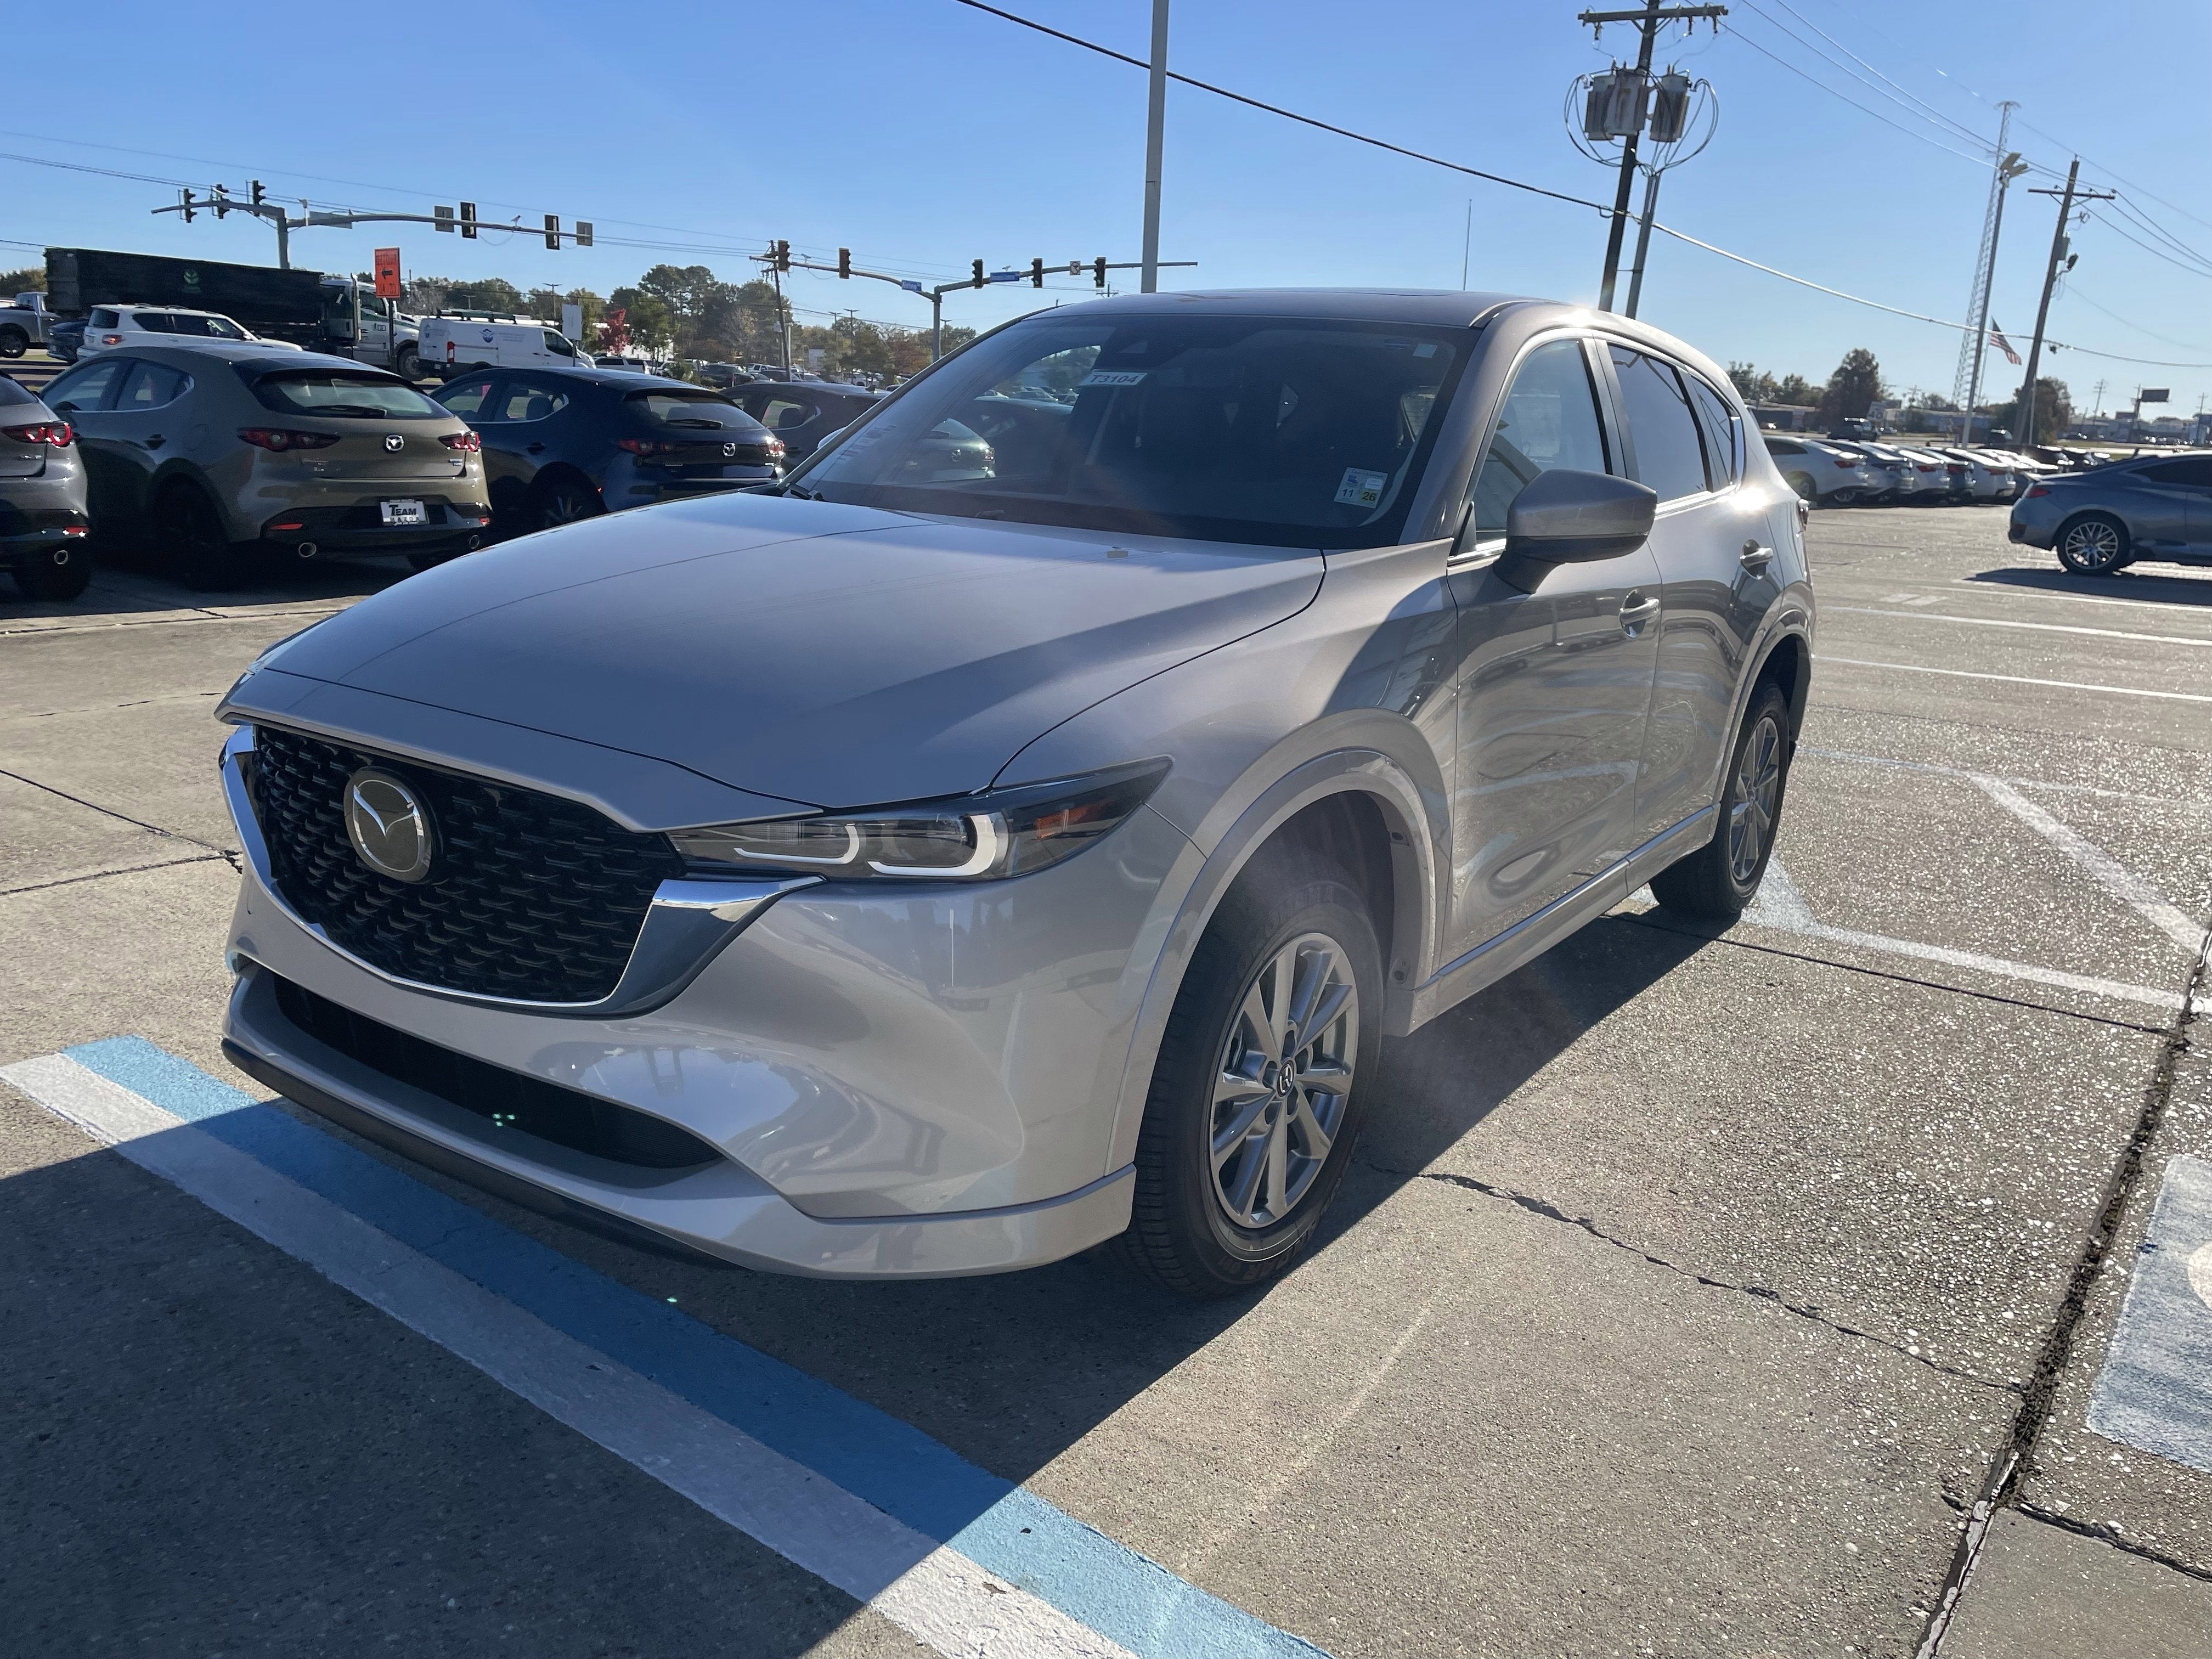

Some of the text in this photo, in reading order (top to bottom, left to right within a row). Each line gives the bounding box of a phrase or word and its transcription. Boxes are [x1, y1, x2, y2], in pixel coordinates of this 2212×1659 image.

[1091, 375, 1138, 383] T3104
[1342, 488, 1376, 501] 11 26
